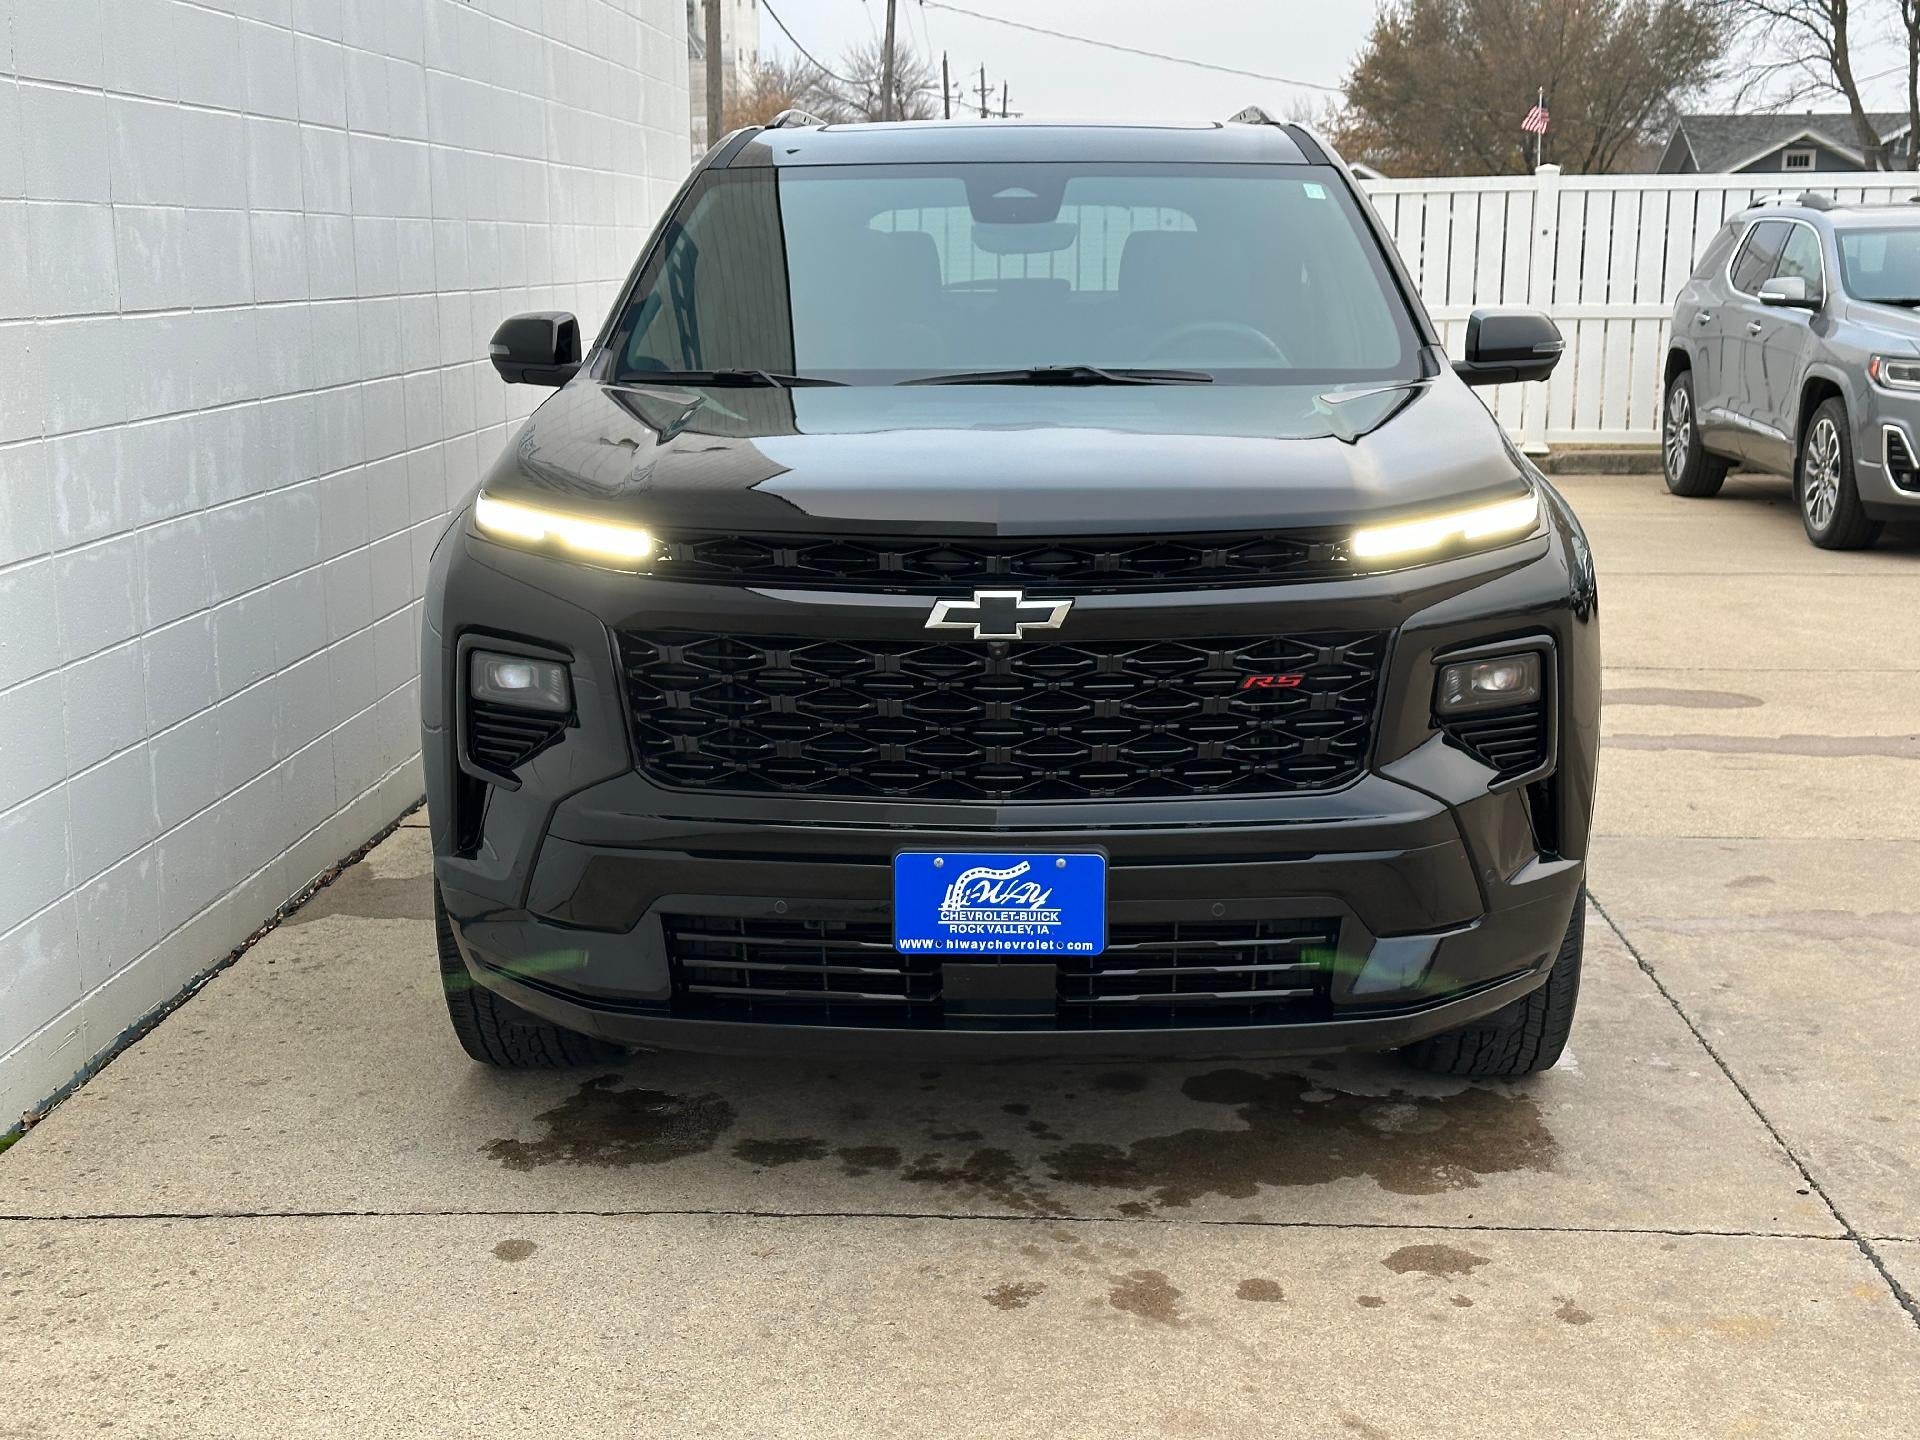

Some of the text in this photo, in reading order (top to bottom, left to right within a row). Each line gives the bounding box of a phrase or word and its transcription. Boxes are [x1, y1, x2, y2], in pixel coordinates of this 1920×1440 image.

[1241, 674, 1304, 689] RS
[940, 911, 1059, 921] CHEVROLET-BUICK
[949, 924, 1050, 936] ROCK VALLEY, IA
